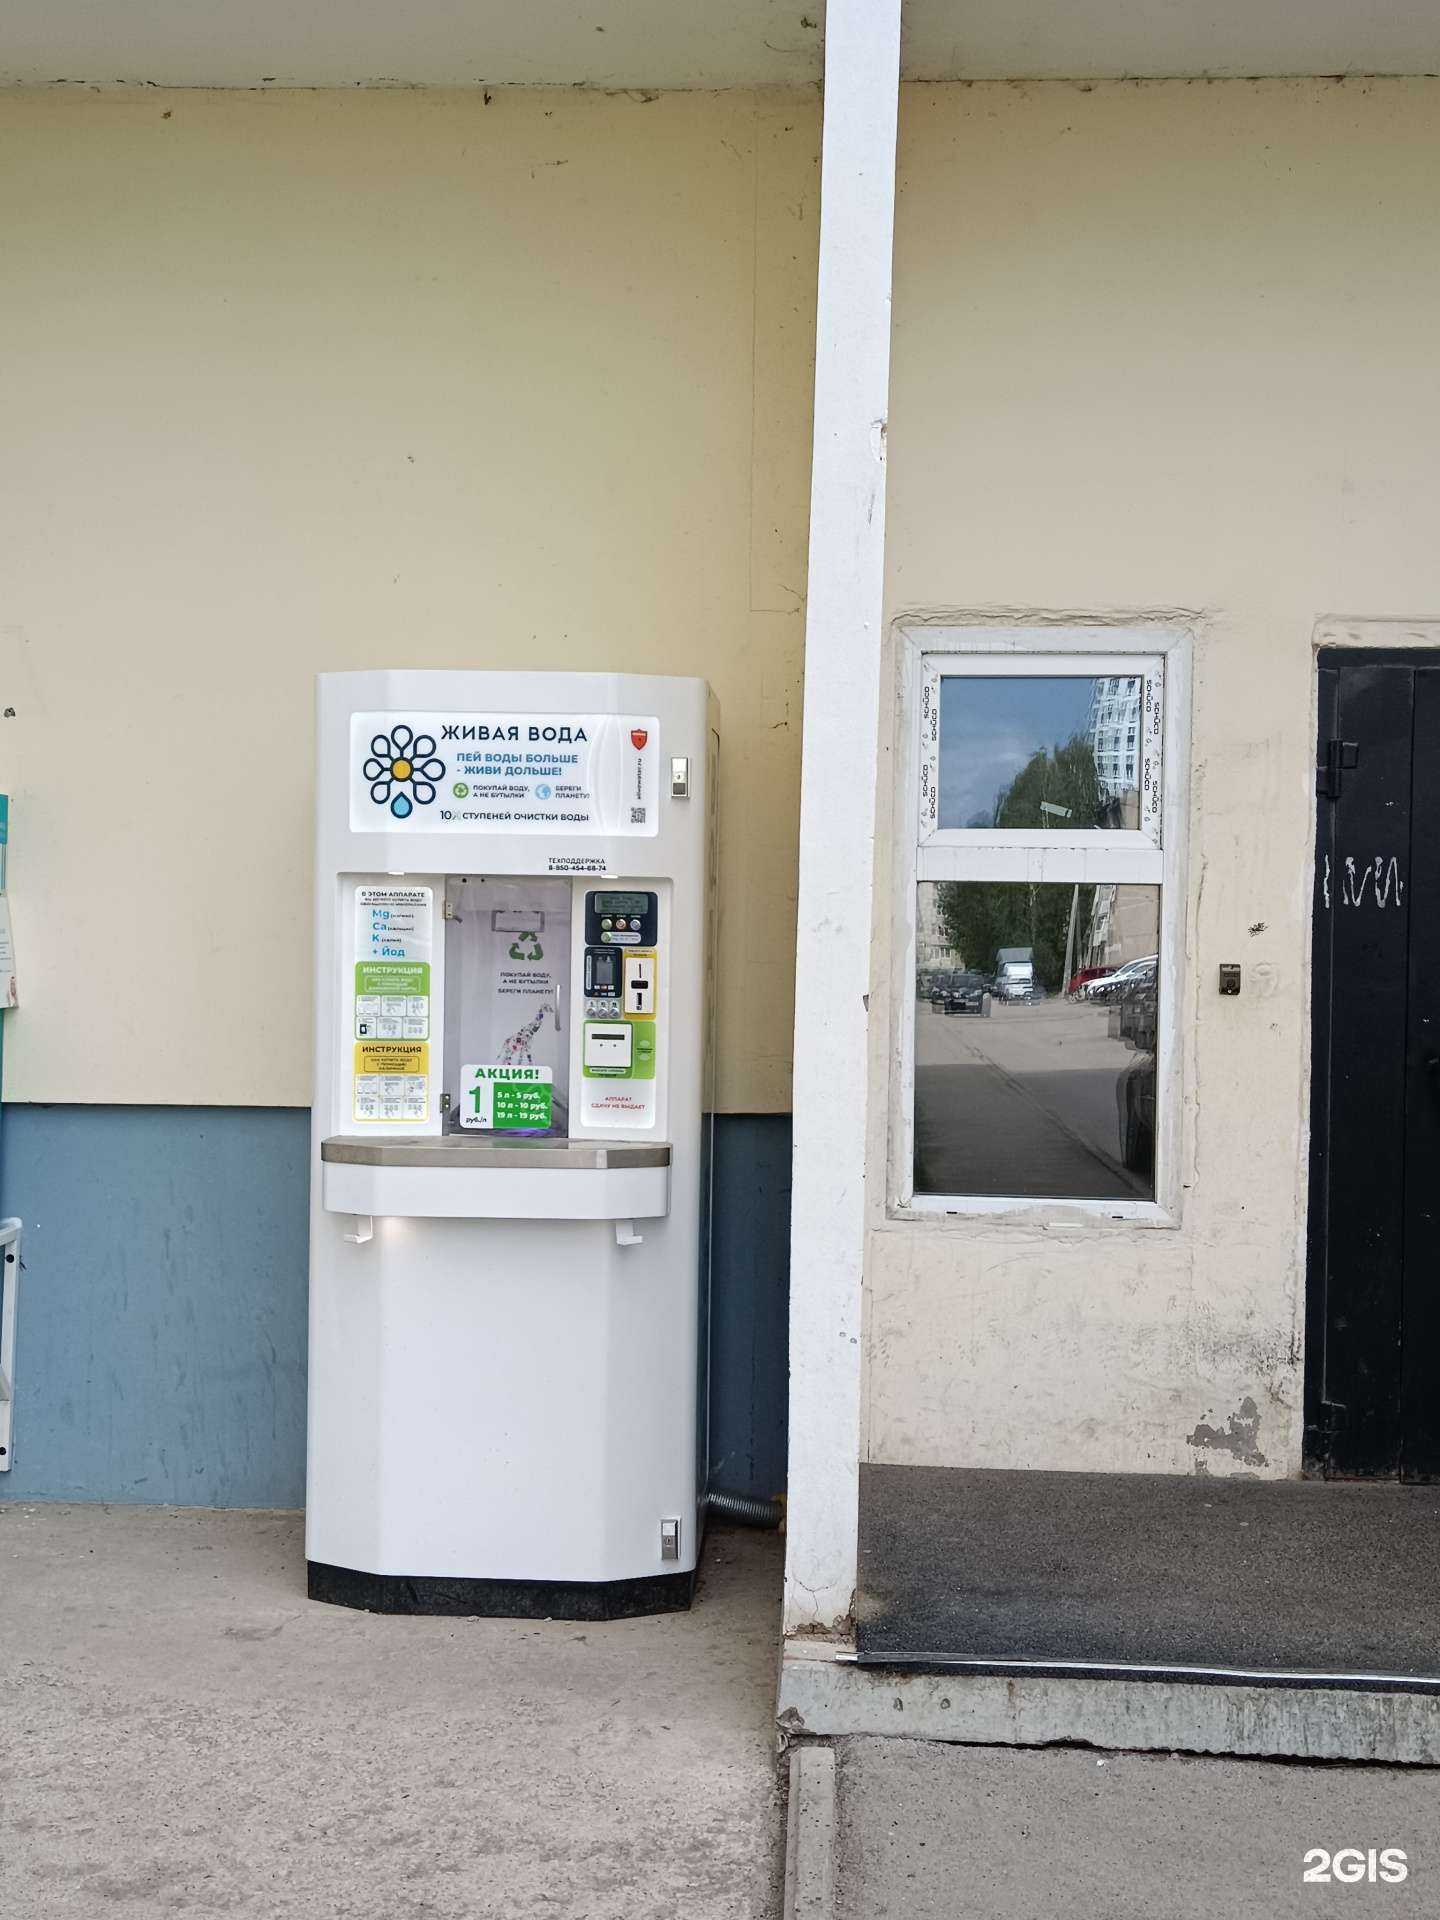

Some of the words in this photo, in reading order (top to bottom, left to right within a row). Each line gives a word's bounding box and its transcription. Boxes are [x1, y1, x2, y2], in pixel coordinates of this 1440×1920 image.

[441, 725, 519, 741] ЖИВАЯ
[528, 726, 587, 744] ВОДА
[457, 751, 481, 762] ПЕЙ
[485, 753, 522, 764] ВОДЫ
[526, 754, 578, 764] БОЛЬШЕ
[464, 766, 501, 775] ЖИВИ
[505, 766, 562, 776] ДОЛЬШЕ!
[462, 811, 511, 820] СТУПЕНЕЙ
[514, 813, 558, 821] ОЧИСТКИ
[560, 813, 589, 822] ВОДЫ
[548, 857, 606, 865] ТЕХПОДДЕРЖКА
[372, 909, 390, 919] Mg
[373, 922, 387, 931] Ca
[382, 946, 405, 957] Йод
[362, 966, 423, 975] ИНСТРУКЦИЯ
[475, 1068, 539, 1080] АКЦИЯ!
[469, 1085, 481, 1113] 1
[523, 1092, 541, 1100] руб.
[530, 1102, 548, 1110] руб.
[529, 1112, 547, 1120] руб.
